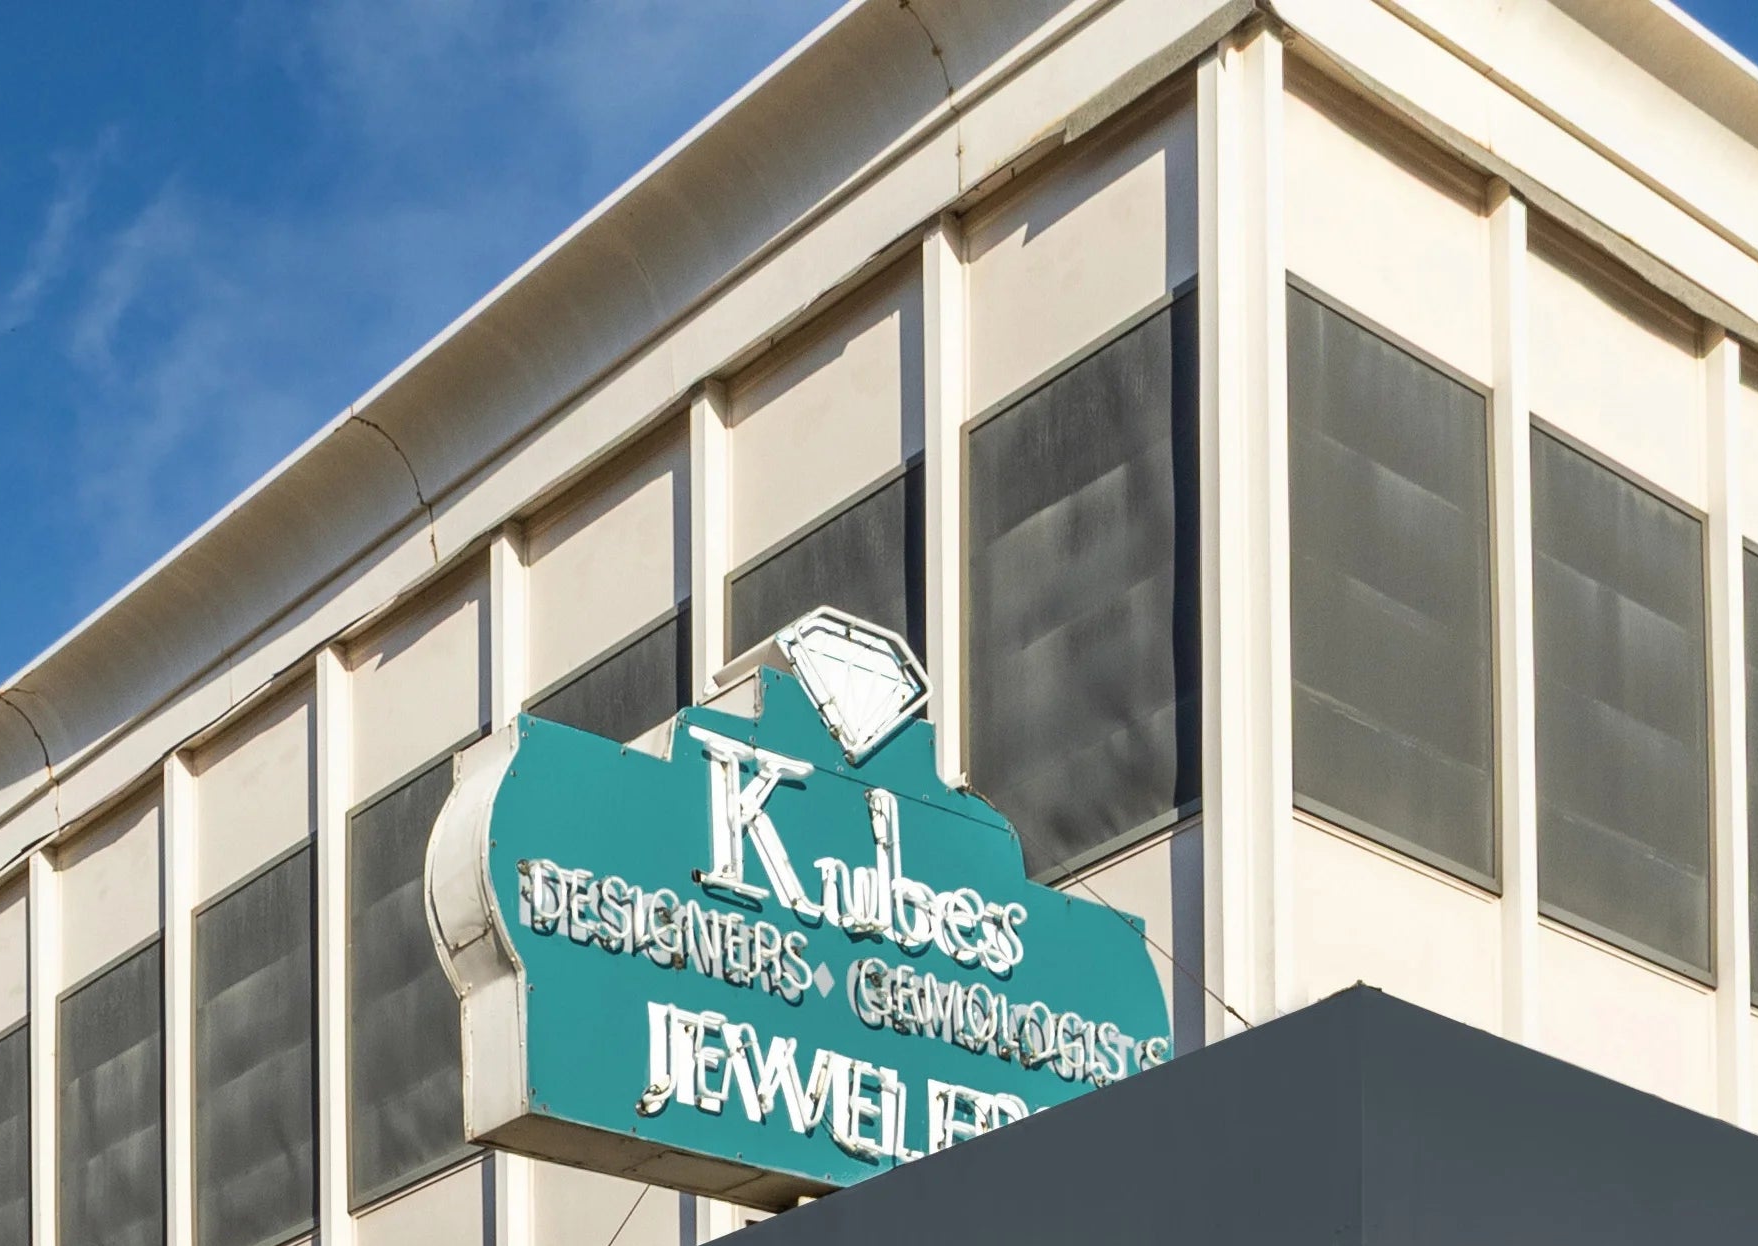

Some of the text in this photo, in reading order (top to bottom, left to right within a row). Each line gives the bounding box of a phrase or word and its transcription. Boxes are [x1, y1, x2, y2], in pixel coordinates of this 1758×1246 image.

[688, 726, 1028, 973] Kubes
[517, 858, 814, 1004] DESIGNERS
[637, 1001, 1053, 1162] JEWELE
